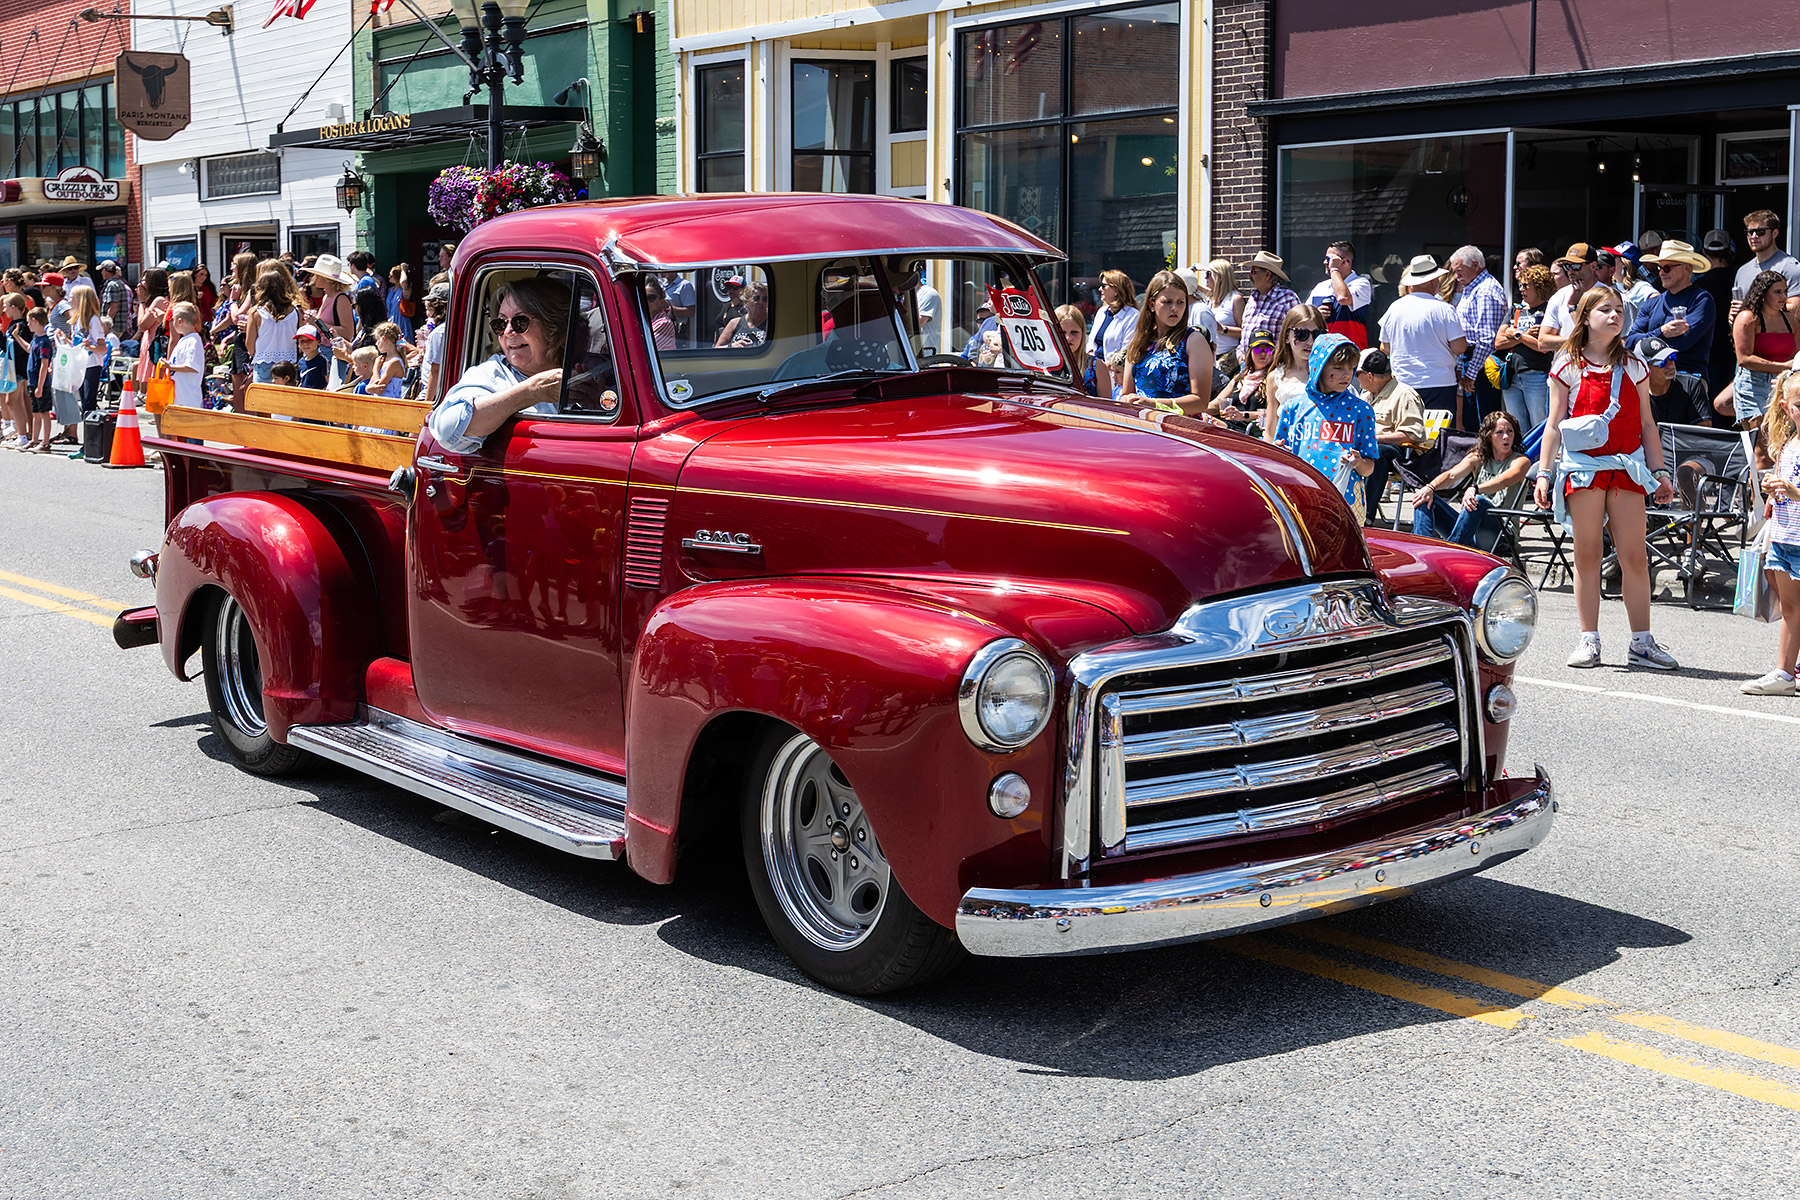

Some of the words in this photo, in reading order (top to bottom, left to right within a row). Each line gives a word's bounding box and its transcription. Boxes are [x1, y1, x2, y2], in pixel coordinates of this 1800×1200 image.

[121, 111, 145, 119] PARIS
[147, 112, 188, 120] MONTANA
[320, 121, 358, 140] FOSTER
[358, 121, 366, 134] &
[367, 114, 411, 134] LOGAN'S
[46, 183, 87, 192] GRIZZLY
[90, 184, 115, 194] PEAK
[56, 191, 106, 199] OUTDOORS
[1016, 325, 1045, 351] 205
[1321, 421, 1352, 442] SZN
[695, 529, 752, 545] GMC
[1264, 595, 1373, 637] GMC
